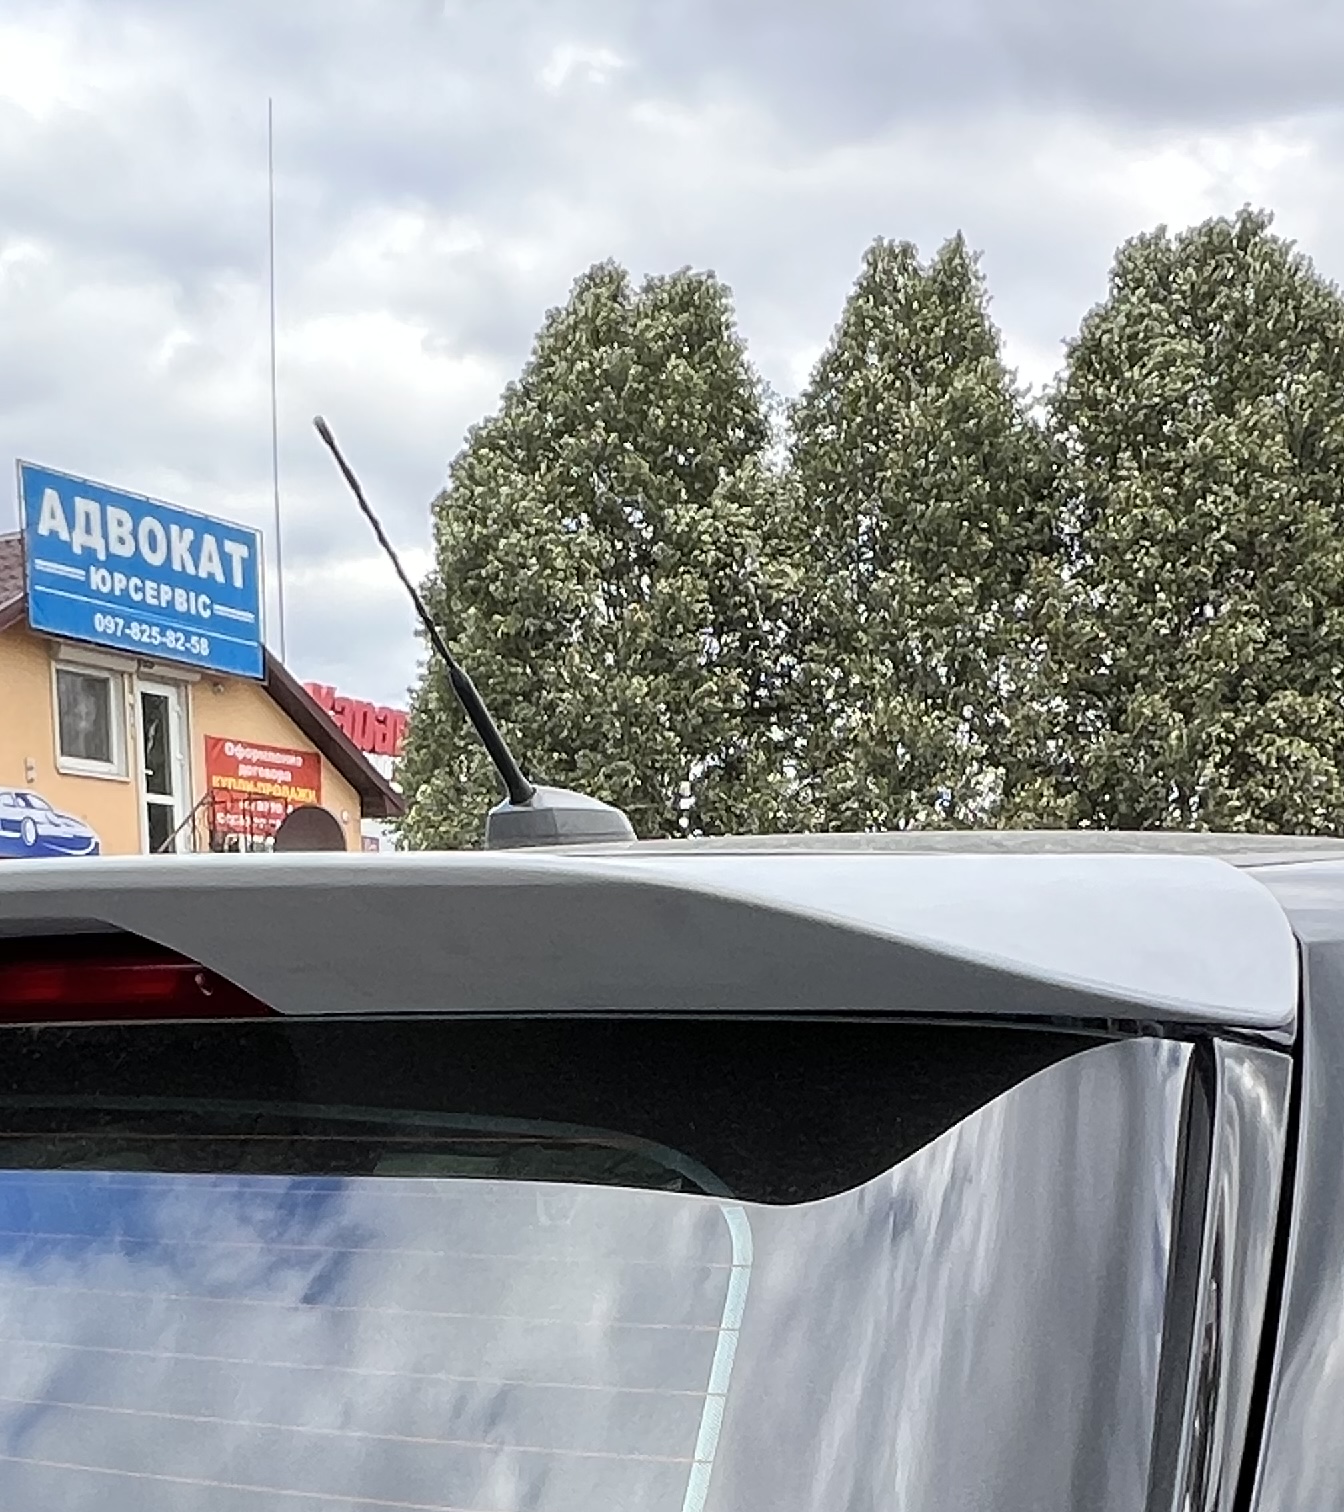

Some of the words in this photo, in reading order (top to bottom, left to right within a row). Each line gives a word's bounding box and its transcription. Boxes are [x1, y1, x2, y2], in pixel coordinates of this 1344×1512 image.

[37, 488, 248, 588] АДВОКАТ
[89, 565, 213, 618] ЮРСЕРВІС
[94, 613, 209, 656] 097-825-82-58
